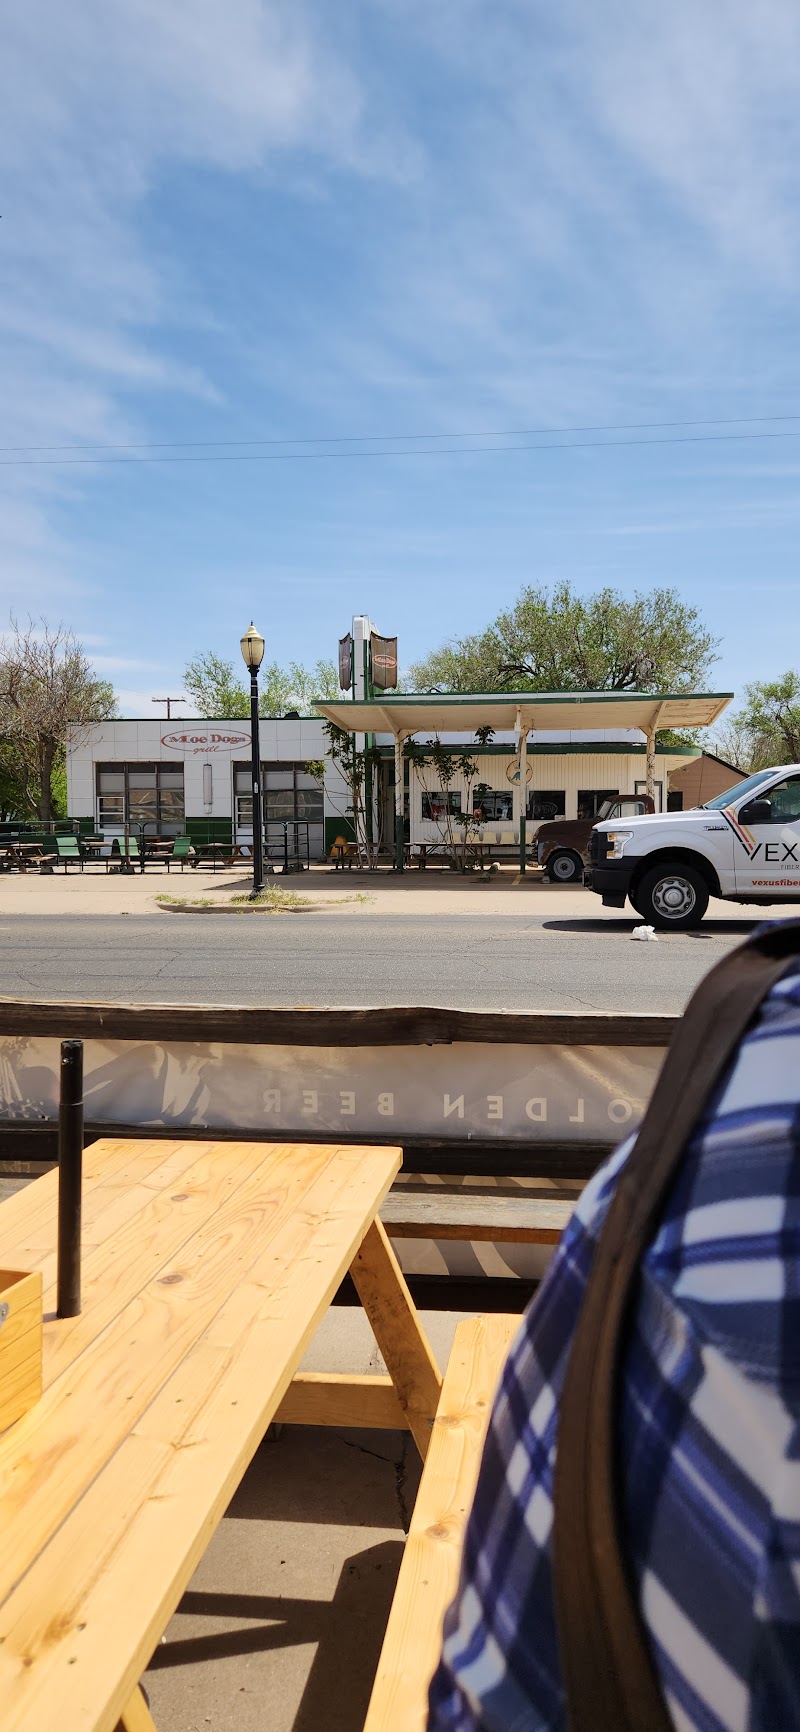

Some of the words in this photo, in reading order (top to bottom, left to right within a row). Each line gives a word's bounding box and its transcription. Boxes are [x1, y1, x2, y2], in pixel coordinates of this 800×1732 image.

[169, 735, 207, 744] Moe
[210, 734, 246, 744] Dogs
[193, 746, 220, 754] grill
